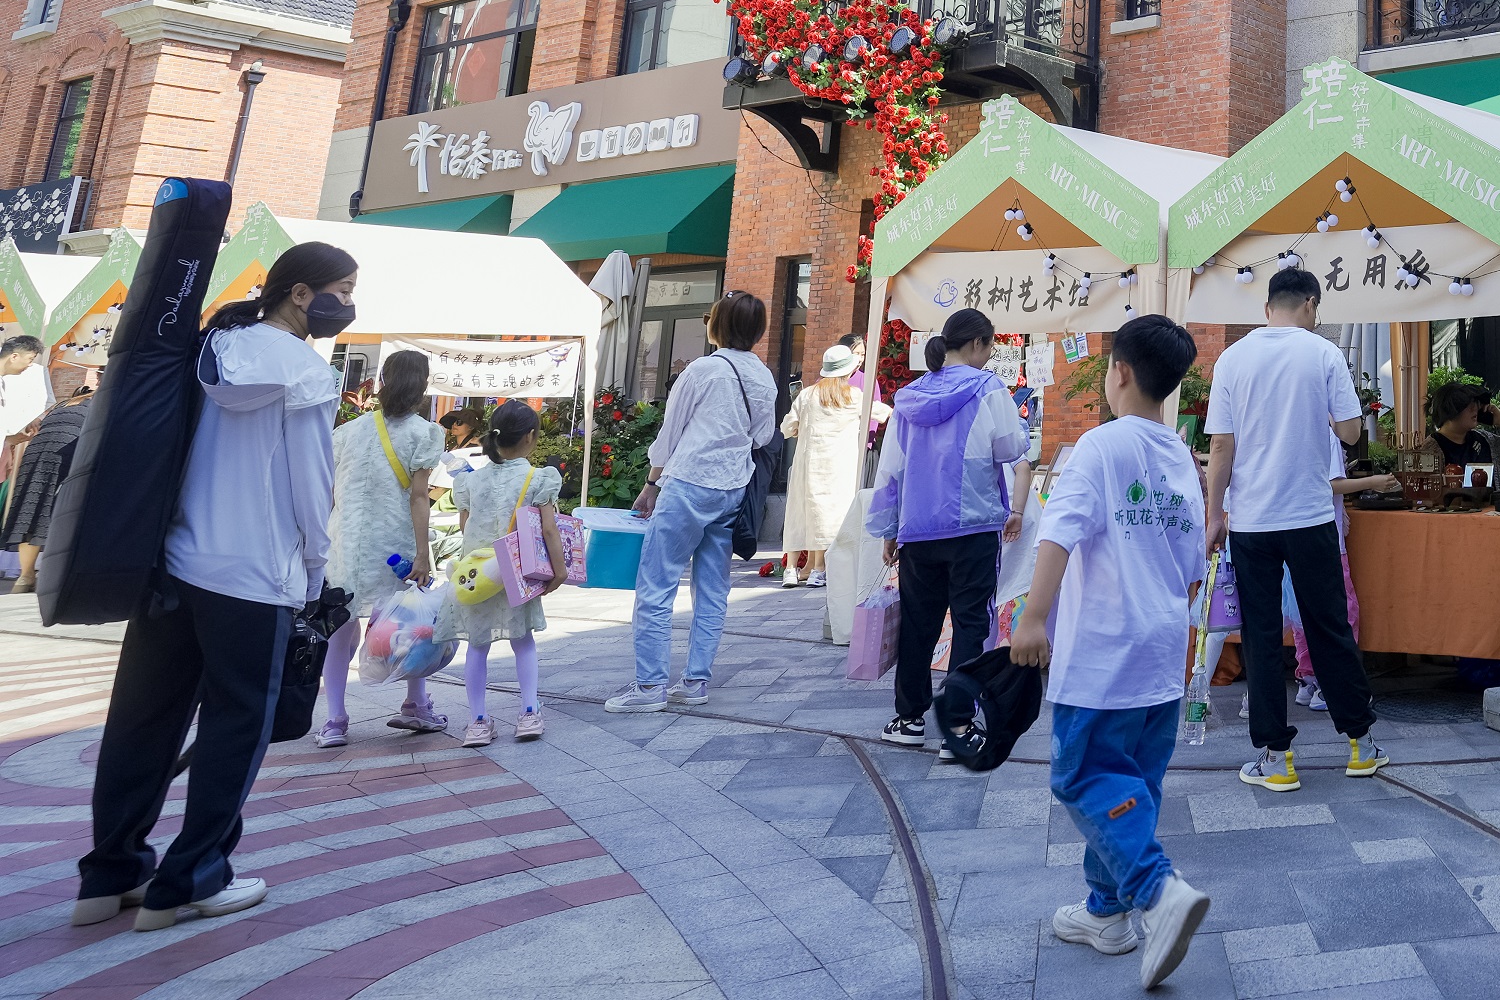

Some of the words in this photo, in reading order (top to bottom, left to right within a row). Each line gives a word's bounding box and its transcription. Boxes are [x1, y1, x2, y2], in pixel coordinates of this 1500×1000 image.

[1303, 60, 1347, 130] 培仁
[1349, 81, 1370, 149] 好物市集
[439, 130, 491, 179] 怡泰
[980, 99, 1016, 157] 培仁
[243, 203, 265, 245] 培仁
[886, 194, 934, 243] 城东好市
[910, 194, 958, 243] 可寻美好
[1184, 172, 1245, 232] 城东好市
[1213, 171, 1277, 230] 可寻美好
[436, 373, 561, 389] 一壶有灵魂的老茶
